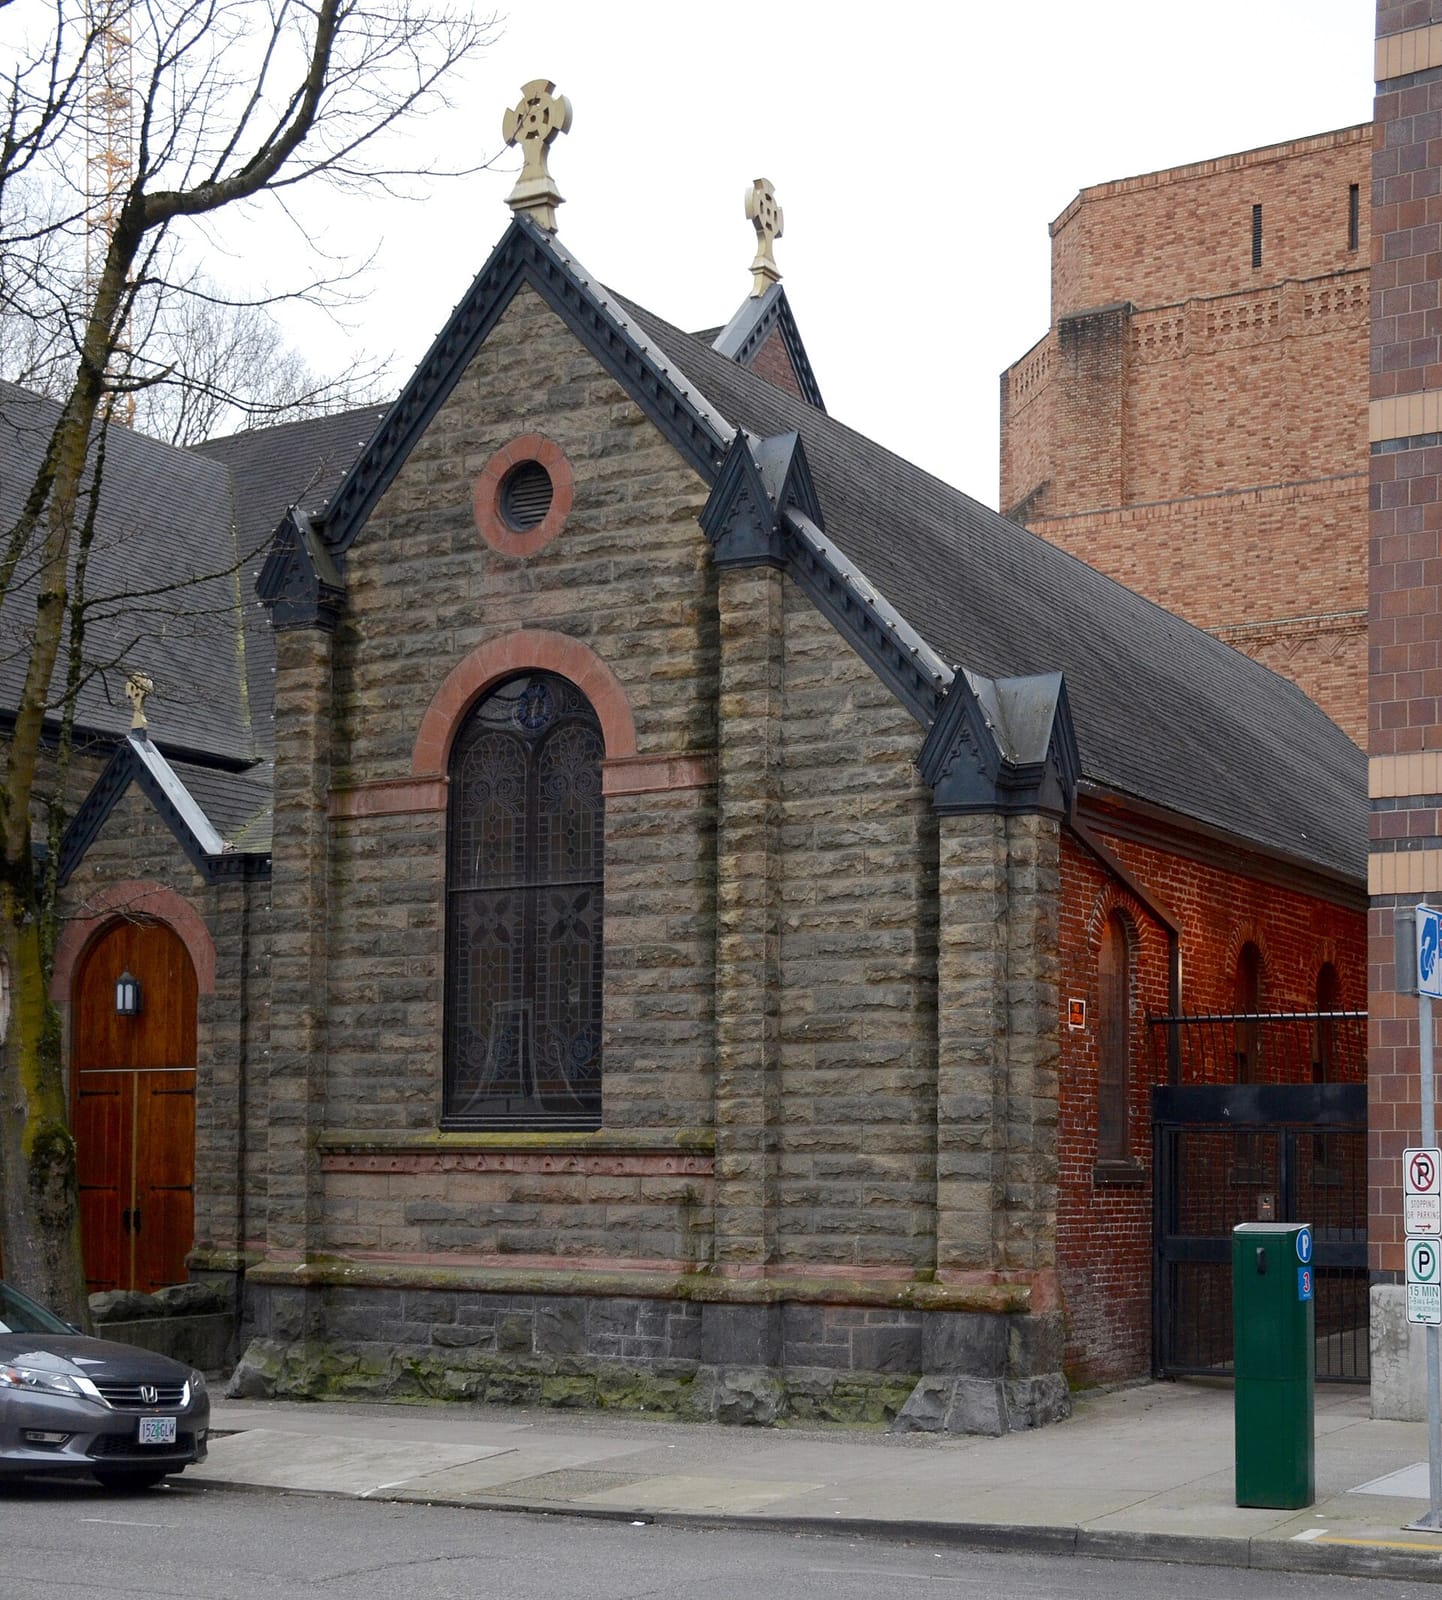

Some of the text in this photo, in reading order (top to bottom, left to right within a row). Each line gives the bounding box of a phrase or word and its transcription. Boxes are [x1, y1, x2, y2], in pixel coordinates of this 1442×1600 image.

[1418, 1250, 1430, 1273] P
[1409, 1285, 1439, 1297] 15 MIN
